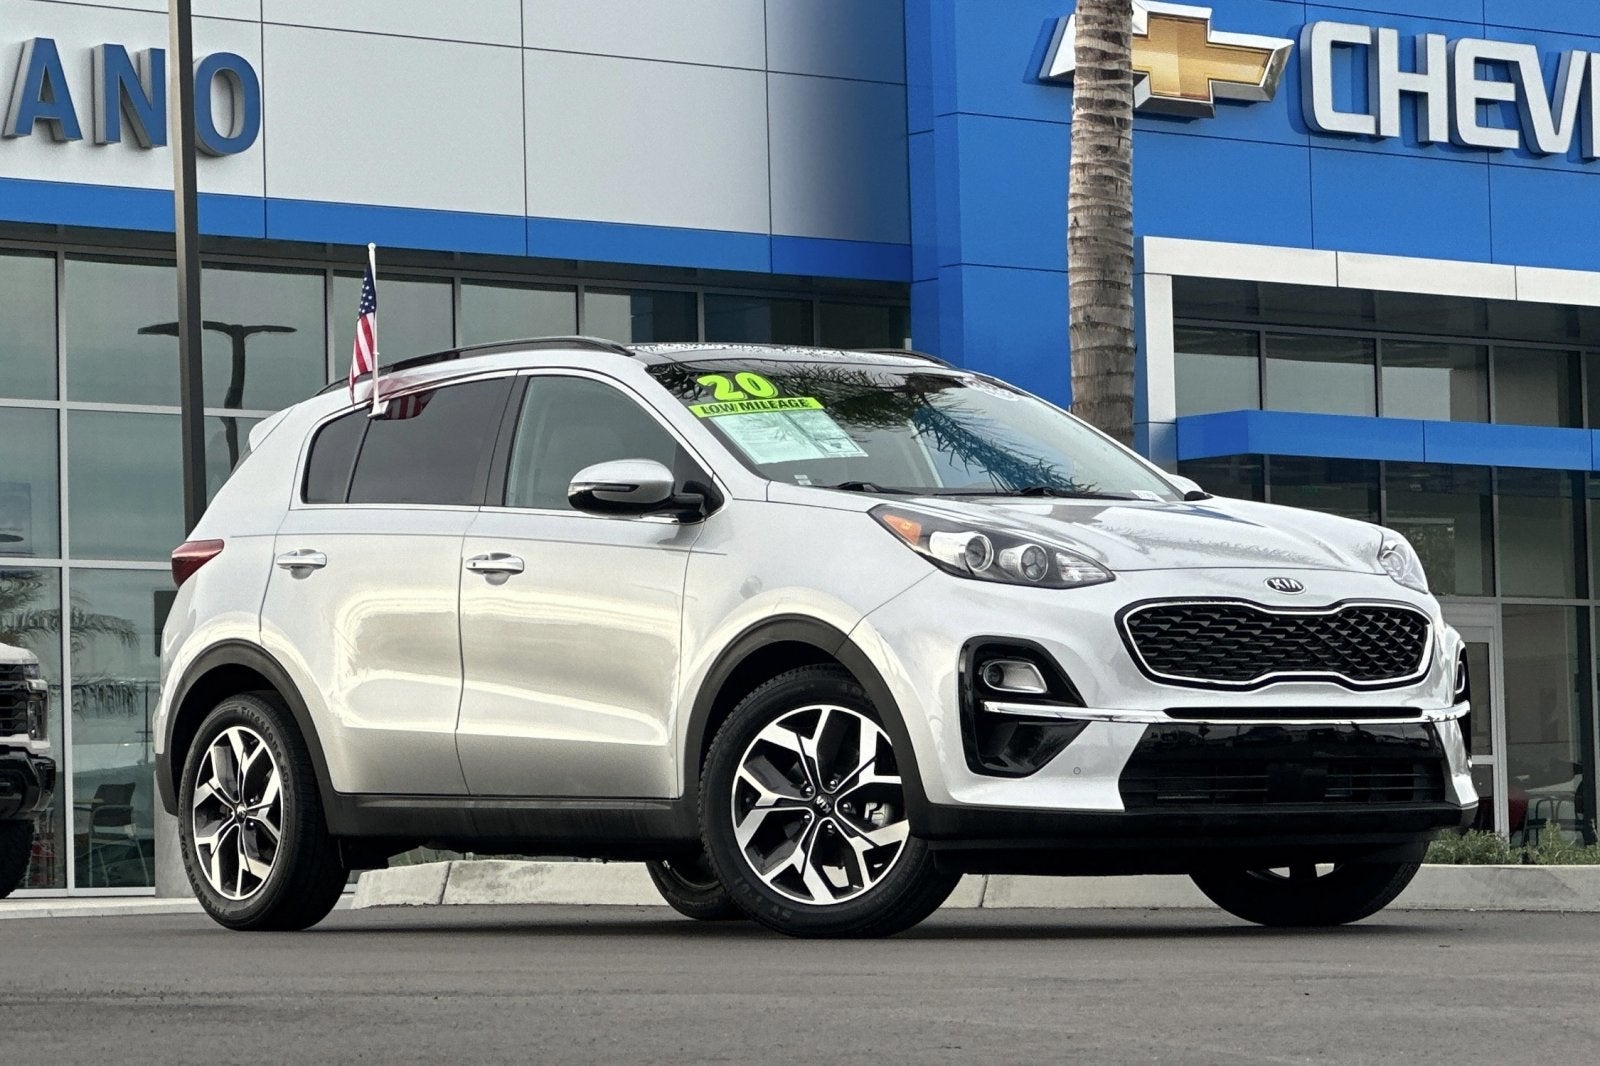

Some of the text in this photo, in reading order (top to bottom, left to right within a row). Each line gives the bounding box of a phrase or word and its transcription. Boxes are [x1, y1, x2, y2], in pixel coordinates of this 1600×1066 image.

[1303, 20, 1600, 158] CHEV
[697, 372, 778, 400] 20
[701, 399, 810, 415] LOW MILEAGE
[1268, 578, 1303, 590] KIA
